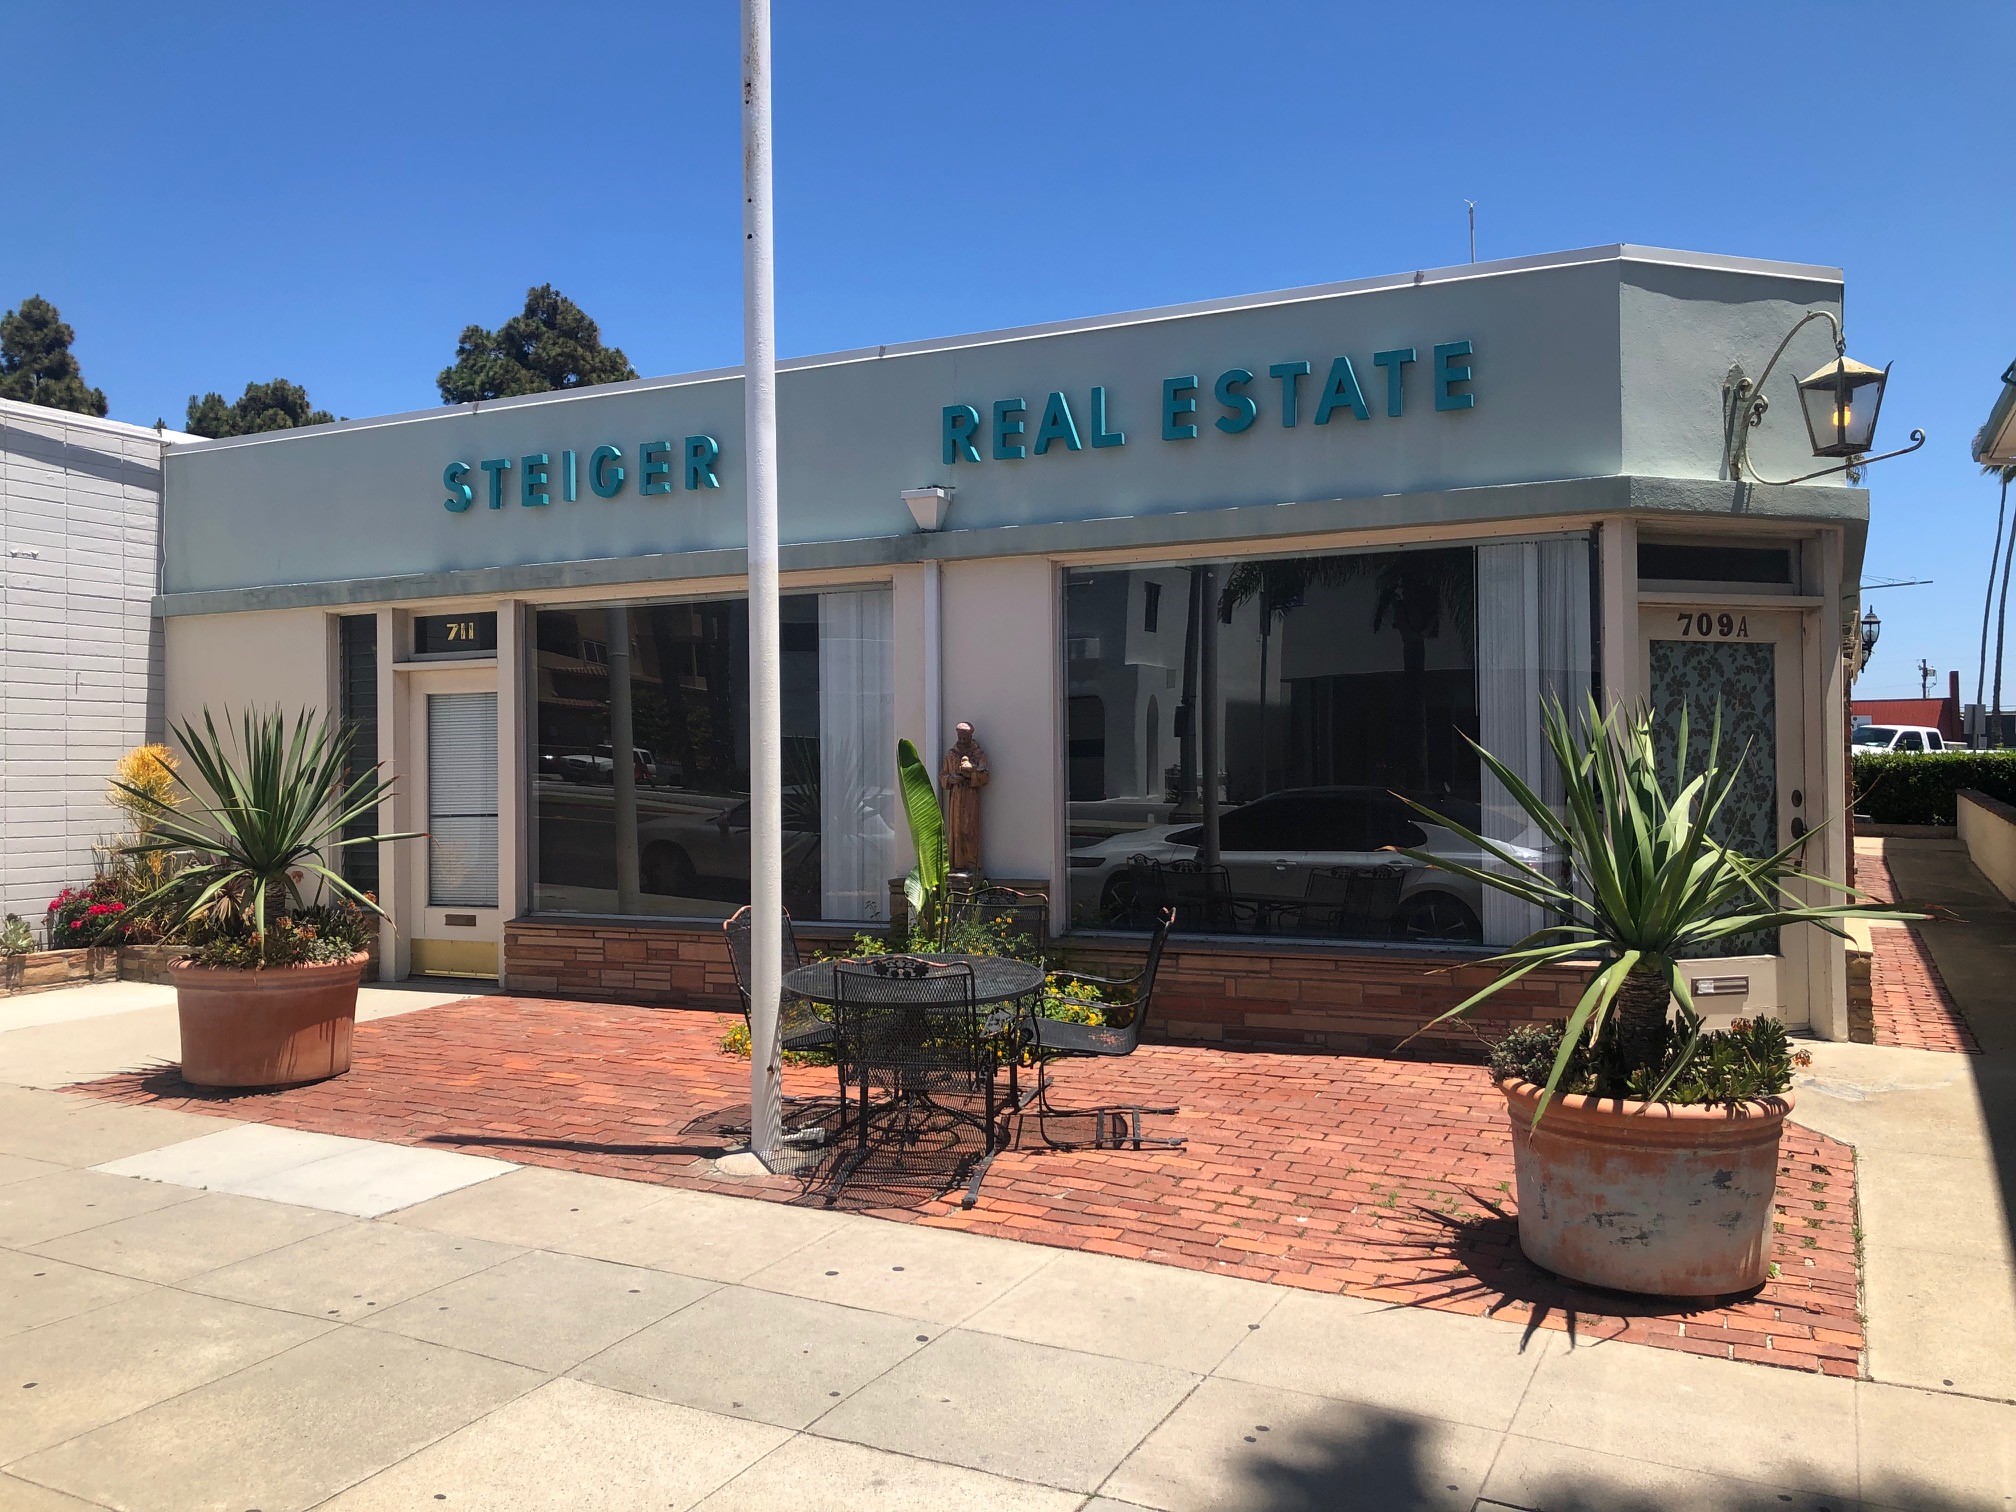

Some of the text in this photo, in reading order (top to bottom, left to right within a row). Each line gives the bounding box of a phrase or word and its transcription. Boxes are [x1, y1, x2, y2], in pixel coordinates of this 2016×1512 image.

[442, 339, 1474, 514] STEIGER REAL ESTATE
[446, 622, 474, 641] 711
[1677, 612, 1749, 638] 709A
